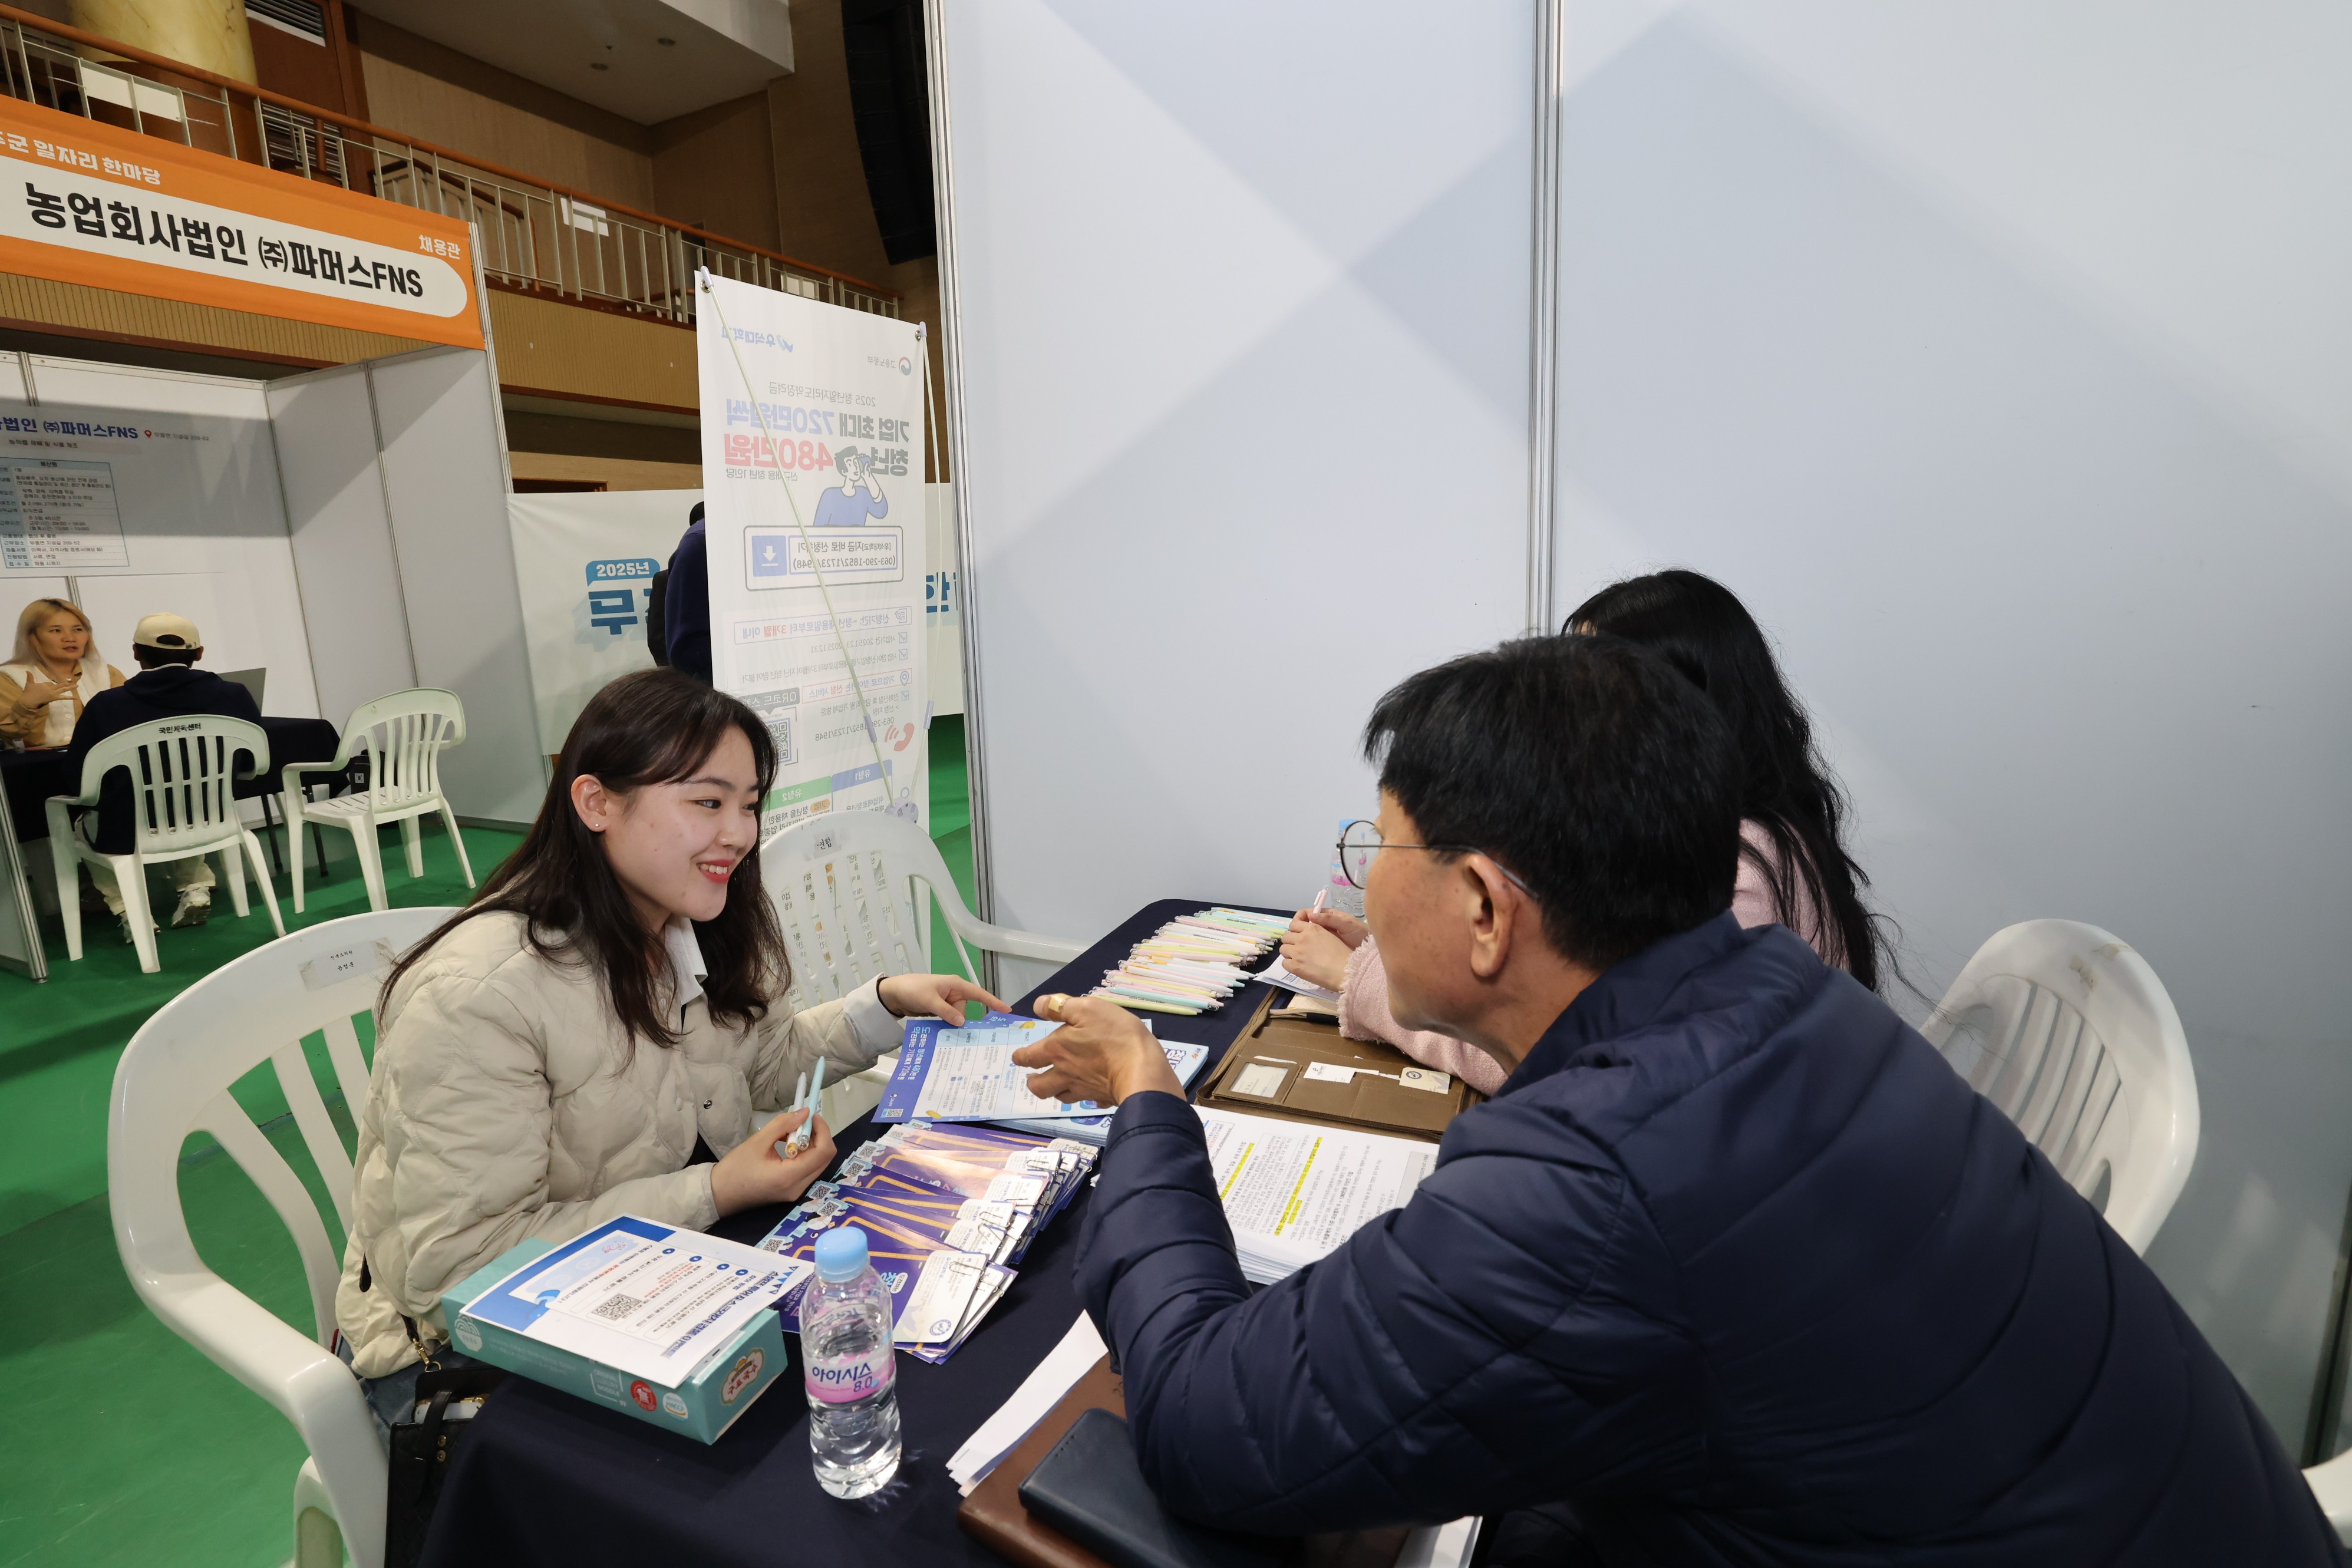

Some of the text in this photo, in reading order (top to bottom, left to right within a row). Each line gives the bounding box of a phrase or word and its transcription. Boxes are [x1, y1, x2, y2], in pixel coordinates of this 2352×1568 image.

[33, 140, 98, 170] 일자리
[102, 157, 160, 185] 한마당
[25, 182, 248, 266] 농업회사법인
[418, 234, 461, 260] 채용관
[0, 417, 37, 433] 법인
[596, 562, 649, 577] 2025년
[588, 588, 652, 635] 무
[909, 1026, 921, 1048] 약진하는
[919, 1026, 930, 1048] 도전하는
[904, 1048, 915, 1064] 기업에게
[915, 1048, 925, 1064] 청년에게
[754, 1270, 781, 1286] 스탬프
[892, 1275, 905, 1292] 도전하는
[740, 1285, 762, 1298] 투어
[703, 1300, 742, 1325] 스크래치
[687, 1323, 711, 1336] 경품
[812, 1363, 872, 1384] 아이시스
[853, 1376, 872, 1392] 8.0
